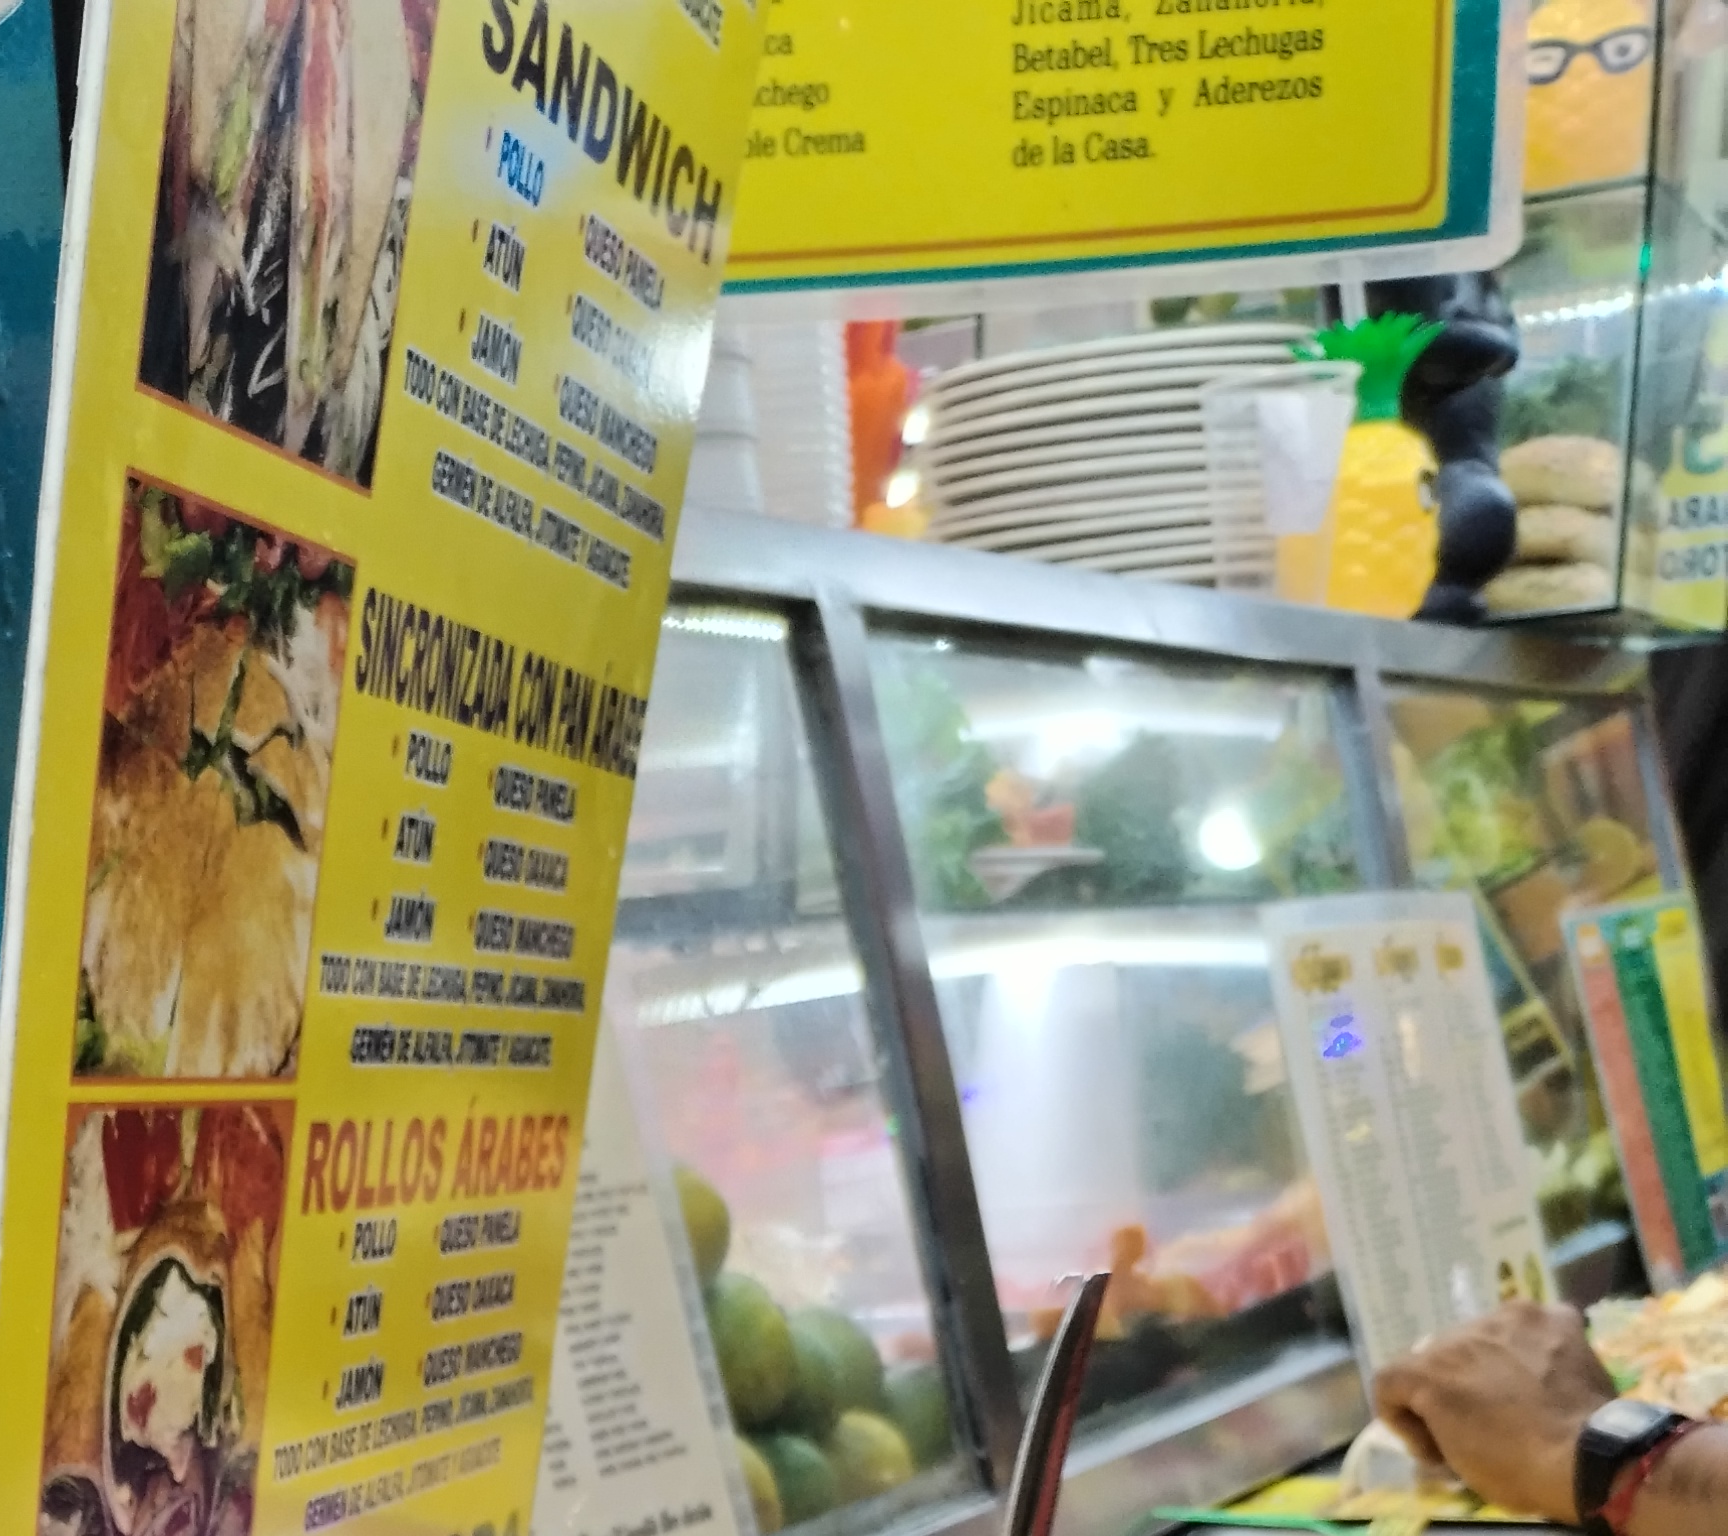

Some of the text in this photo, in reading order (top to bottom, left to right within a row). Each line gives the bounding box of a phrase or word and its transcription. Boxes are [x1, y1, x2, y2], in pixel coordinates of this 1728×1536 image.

[1130, 34, 1189, 65] Tres
[1197, 27, 1323, 60] Lechugas
[1013, 75, 1322, 126] Espinaca y Aderezos
[482, 0, 722, 266] SANDWICH
[784, 127, 866, 156] Crema
[1012, 132, 1156, 167] de la Casa.
[498, 129, 545, 208] POLLO
[355, 586, 515, 738] SINCRONIZADA
[513, 649, 560, 751] CON
[406, 733, 453, 785] POLLO
[301, 1097, 570, 1216] ROLLOS ÁRABES
[352, 1218, 397, 1261] POLLO
